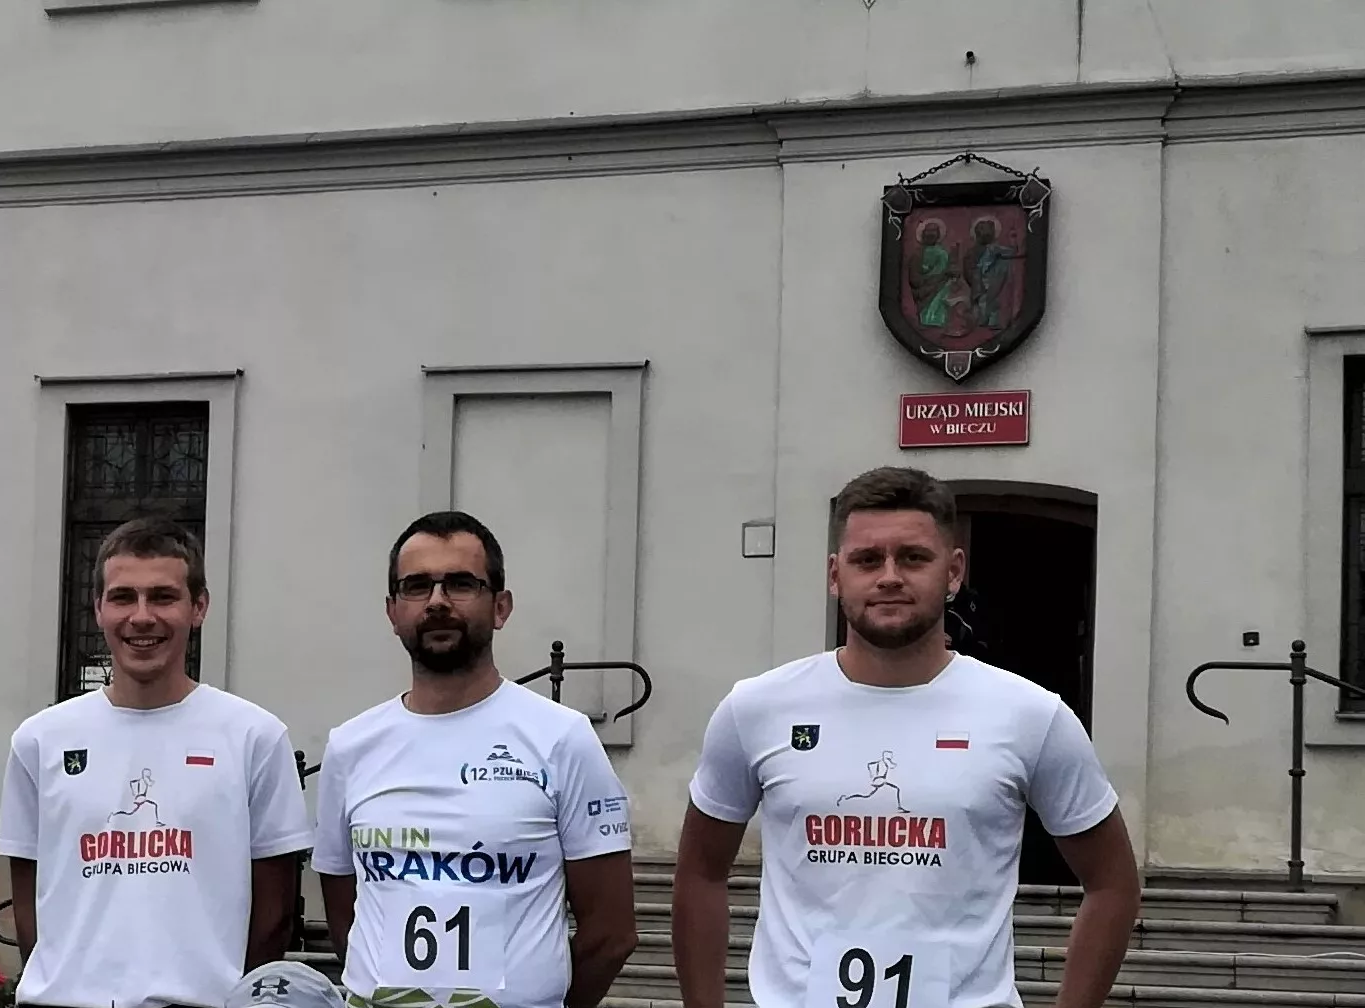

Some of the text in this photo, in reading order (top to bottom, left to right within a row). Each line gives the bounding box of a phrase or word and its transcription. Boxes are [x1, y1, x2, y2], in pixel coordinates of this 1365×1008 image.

[906, 401, 1023, 421] URZĄD MIEJSKI
[930, 423, 996, 434] W BIECZU
[352, 828, 430, 848] RUN IN
[805, 814, 946, 849] GORLICKA
[80, 828, 192, 862] GORLICKA
[127, 860, 190, 875] BIEGOWA
[356, 840, 537, 884] KRAKÓW
[807, 850, 942, 866] GRUPA BIEGOWA
[404, 905, 470, 971] 61
